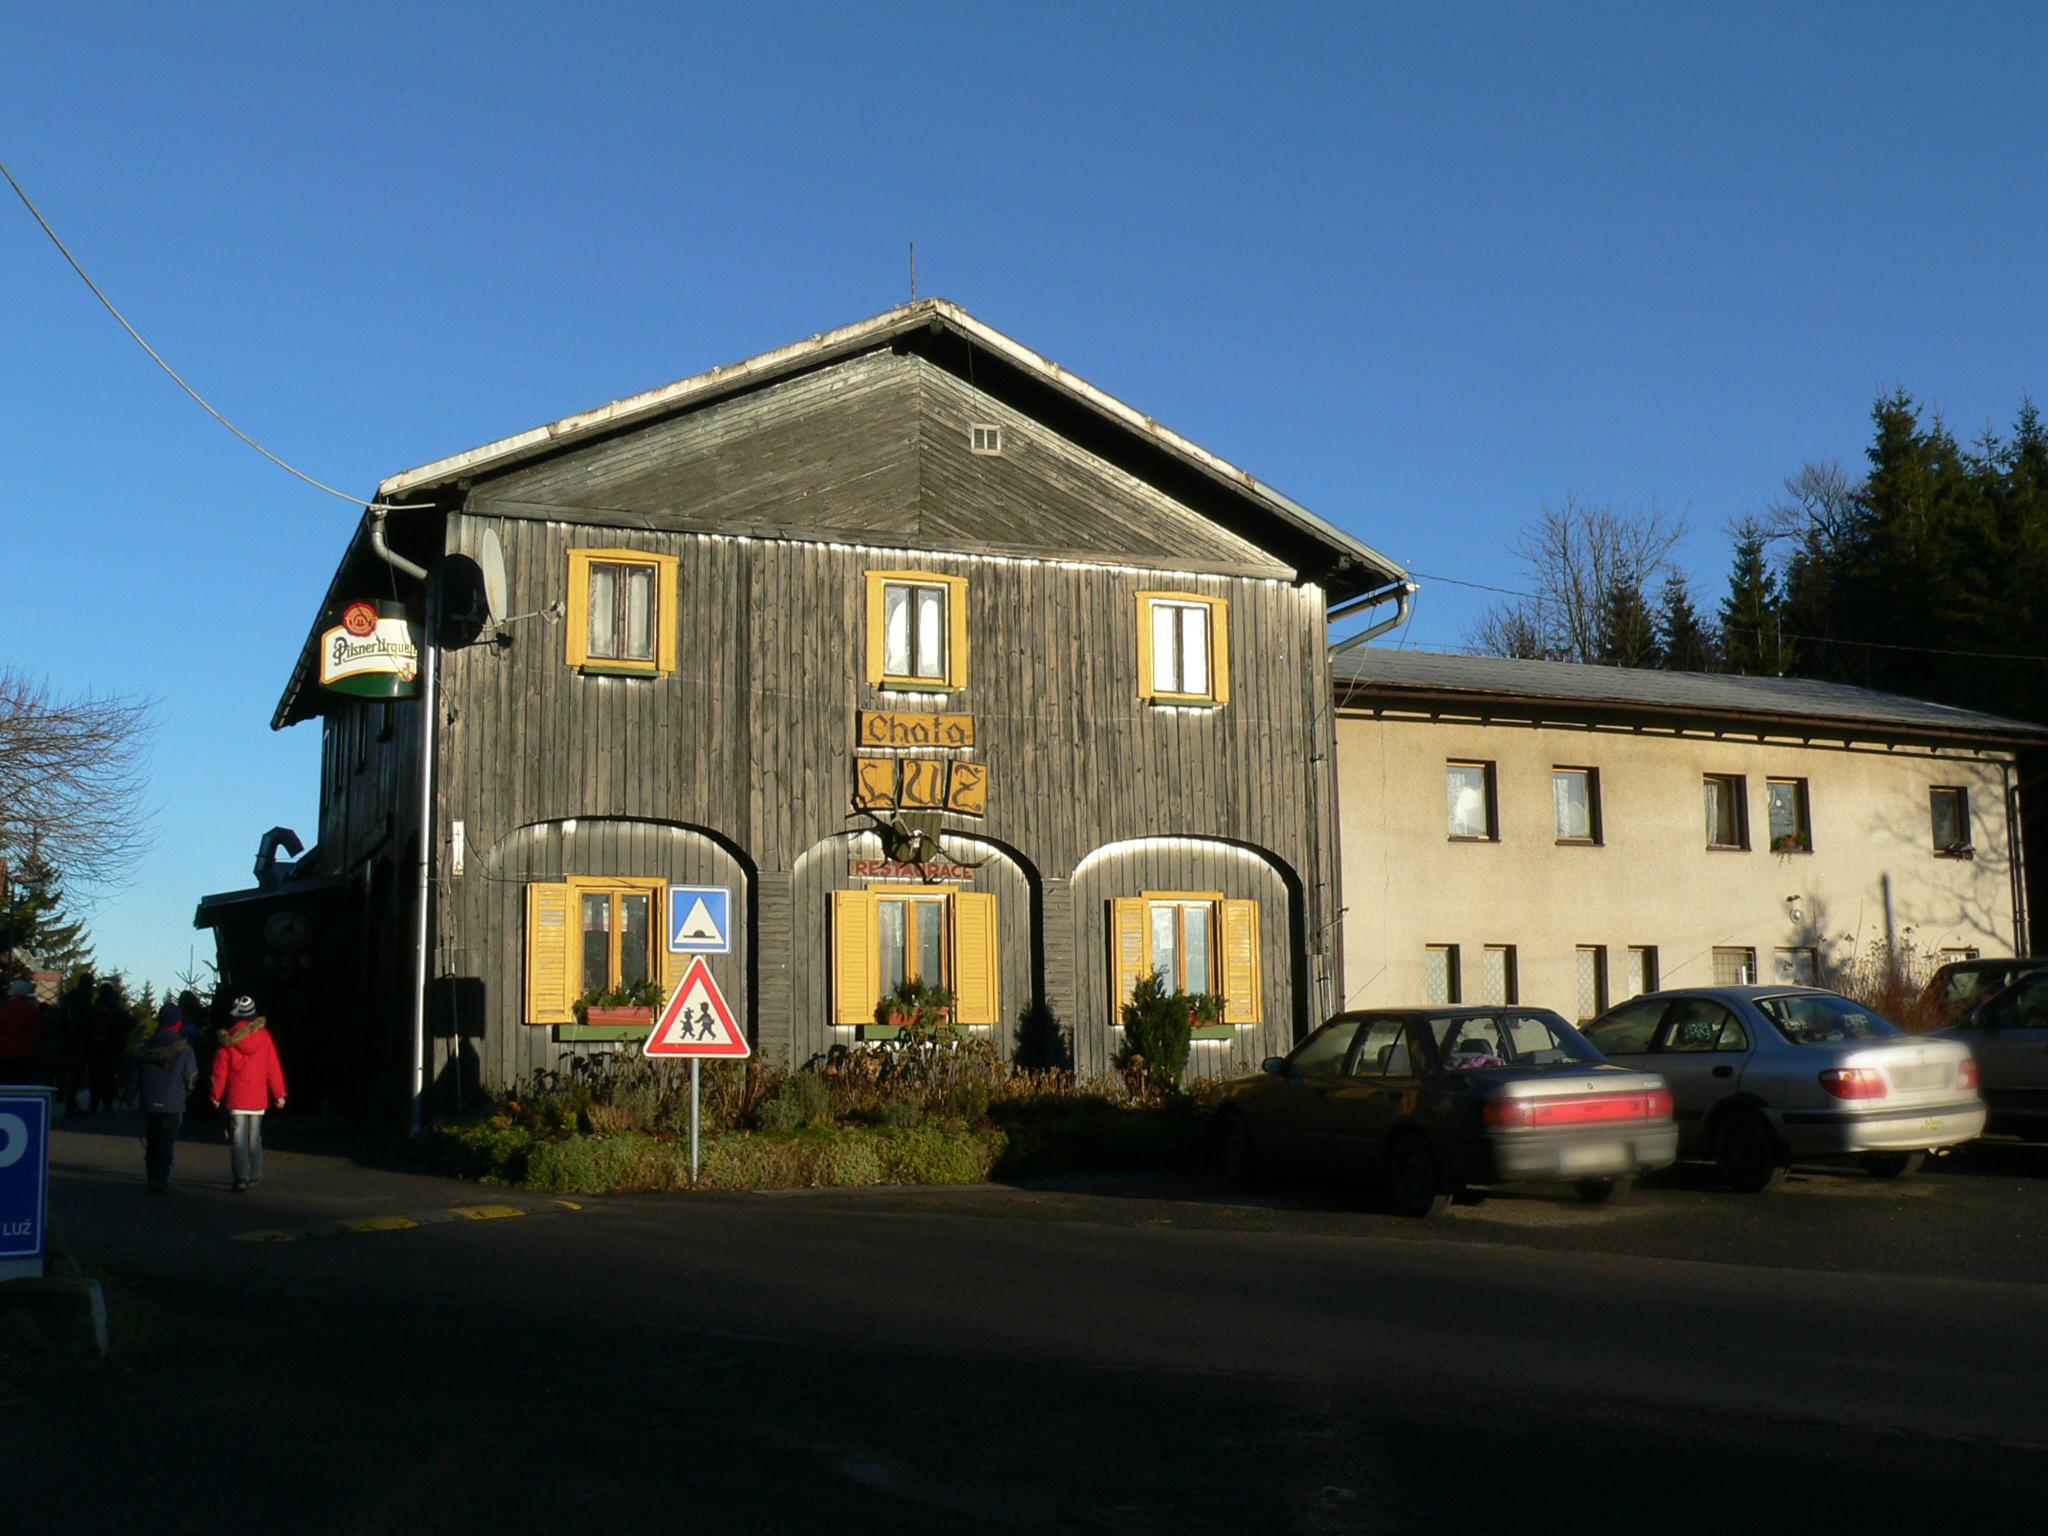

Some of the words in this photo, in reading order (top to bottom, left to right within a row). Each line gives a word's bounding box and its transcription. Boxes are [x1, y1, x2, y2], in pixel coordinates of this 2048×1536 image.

[333, 637, 376, 666] Pilsner
[869, 714, 966, 744] Chata
[3, 1219, 32, 1236] LUŽ
